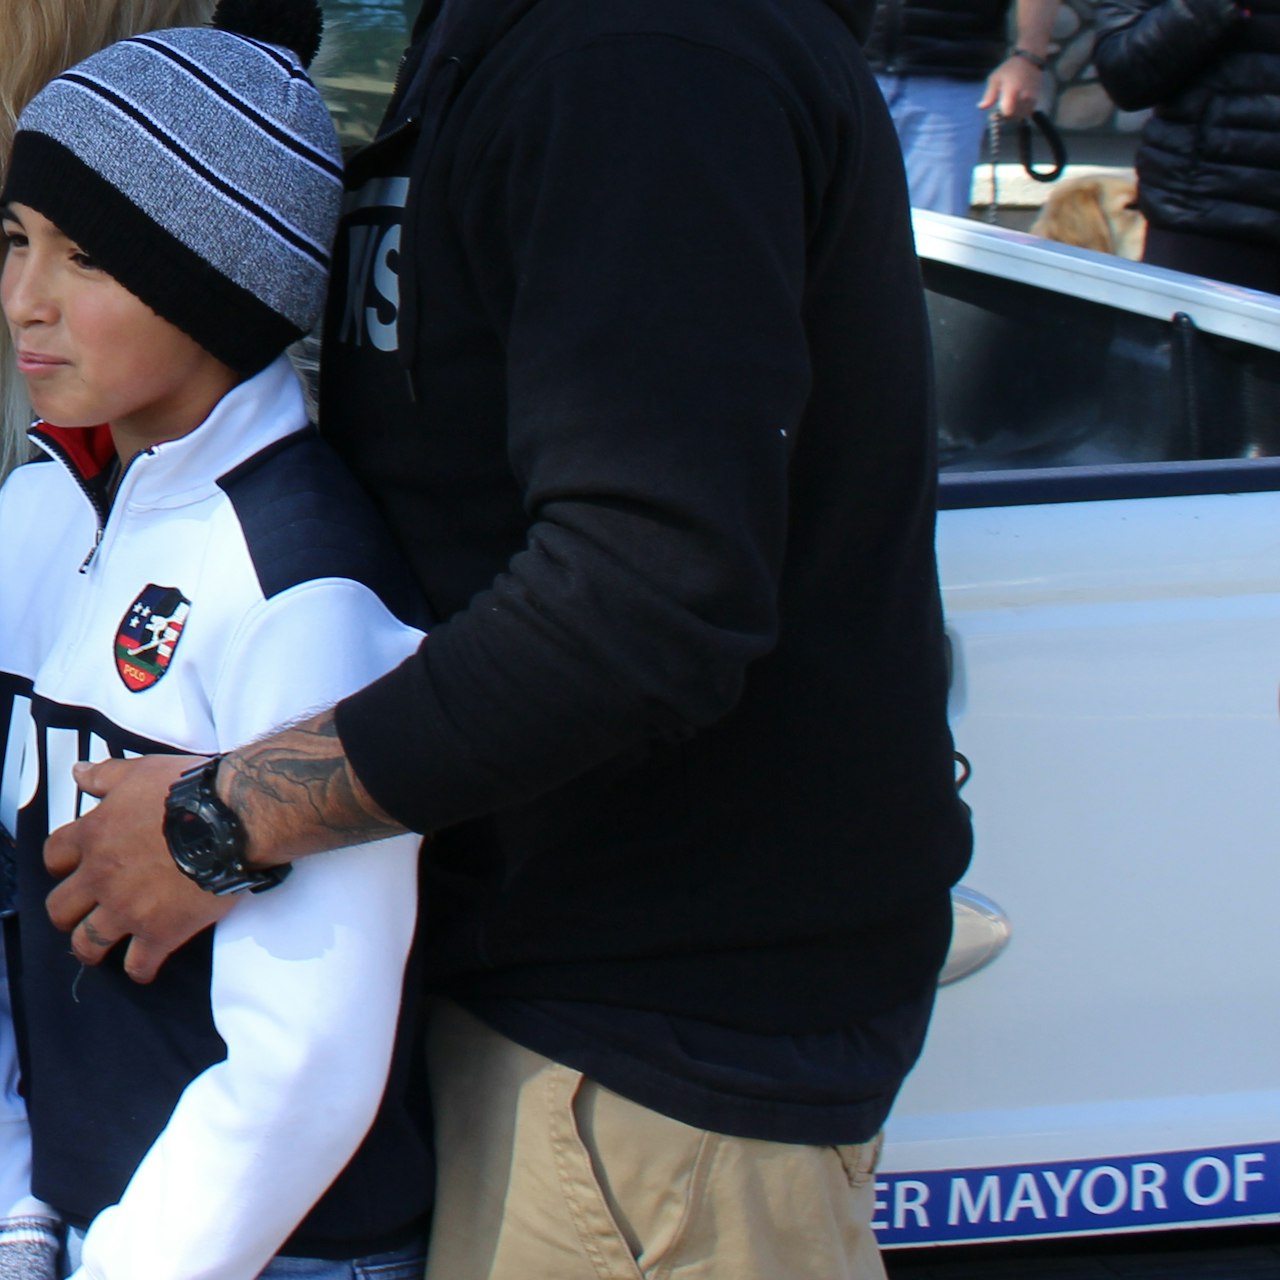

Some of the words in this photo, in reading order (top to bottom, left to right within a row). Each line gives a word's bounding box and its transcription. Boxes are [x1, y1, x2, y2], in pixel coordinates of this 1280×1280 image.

[124, 664, 146, 682] POLO
[947, 1162, 1168, 1226] MAYOR
[1183, 1151, 1267, 1206] OF
